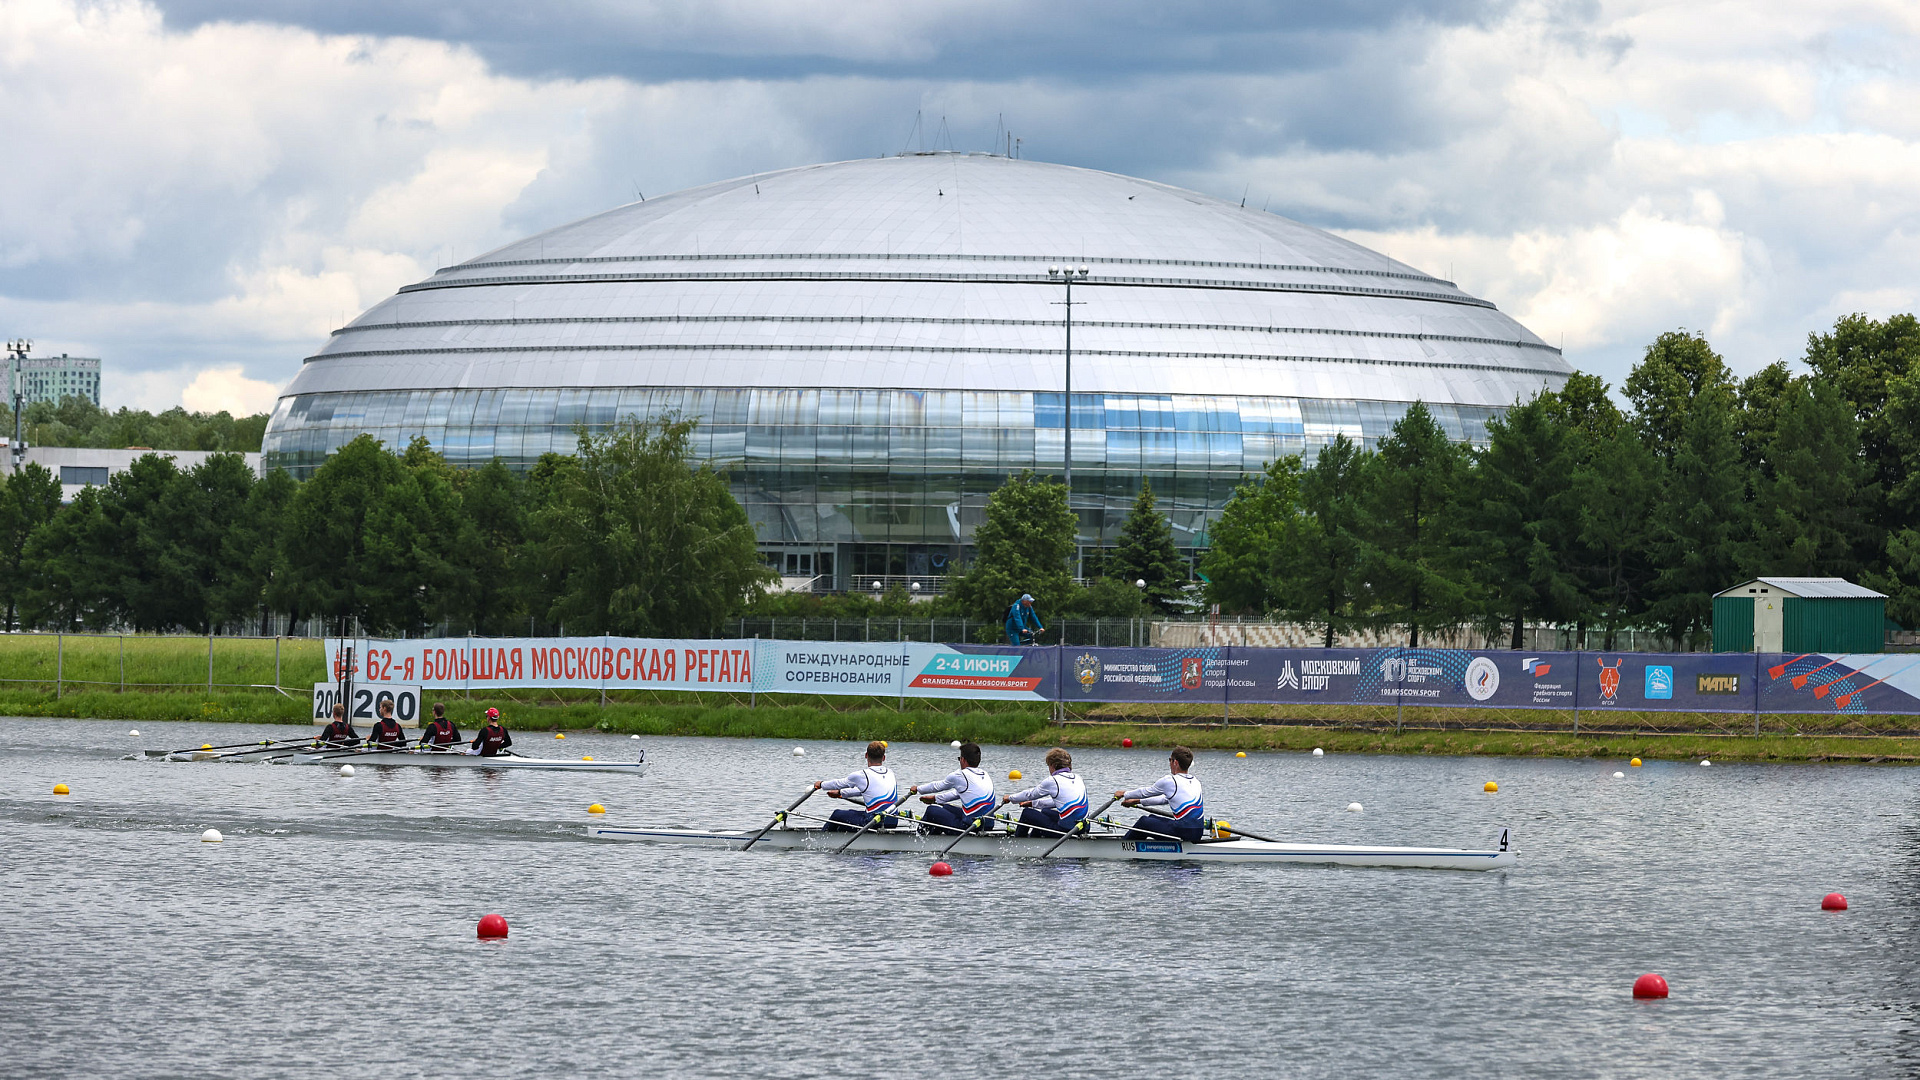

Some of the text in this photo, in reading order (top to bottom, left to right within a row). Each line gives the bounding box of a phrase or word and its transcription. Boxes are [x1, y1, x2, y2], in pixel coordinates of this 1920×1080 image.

[367, 647, 751, 683] 62-я БОЛЬШАЯ МОСКОВСКАЯ РЕГАТА
[786, 653, 910, 667] МЕЖДУНАРОДНЫЕ
[964, 659, 1009, 672] ИЮНЯ
[1206, 659, 1249, 667] Департамент
[1301, 657, 1360, 675] МОСКОВСКИЙ
[786, 670, 891, 684] СОРЕВНОВАНИЯ
[1205, 669, 1226, 677] спорта
[922, 678, 1028, 688] GRANDREGATTA.MOSCOW.SPORT
[1205, 679, 1256, 688] города Москвы
[1302, 676, 1330, 690] СПОРТ
[1699, 677, 1737, 692] МАТЧ!
[353, 689, 416, 720] 200
[639, 749, 645, 763] 2
[1121, 842, 1136, 851] RUS
[1499, 828, 1508, 852] 4
